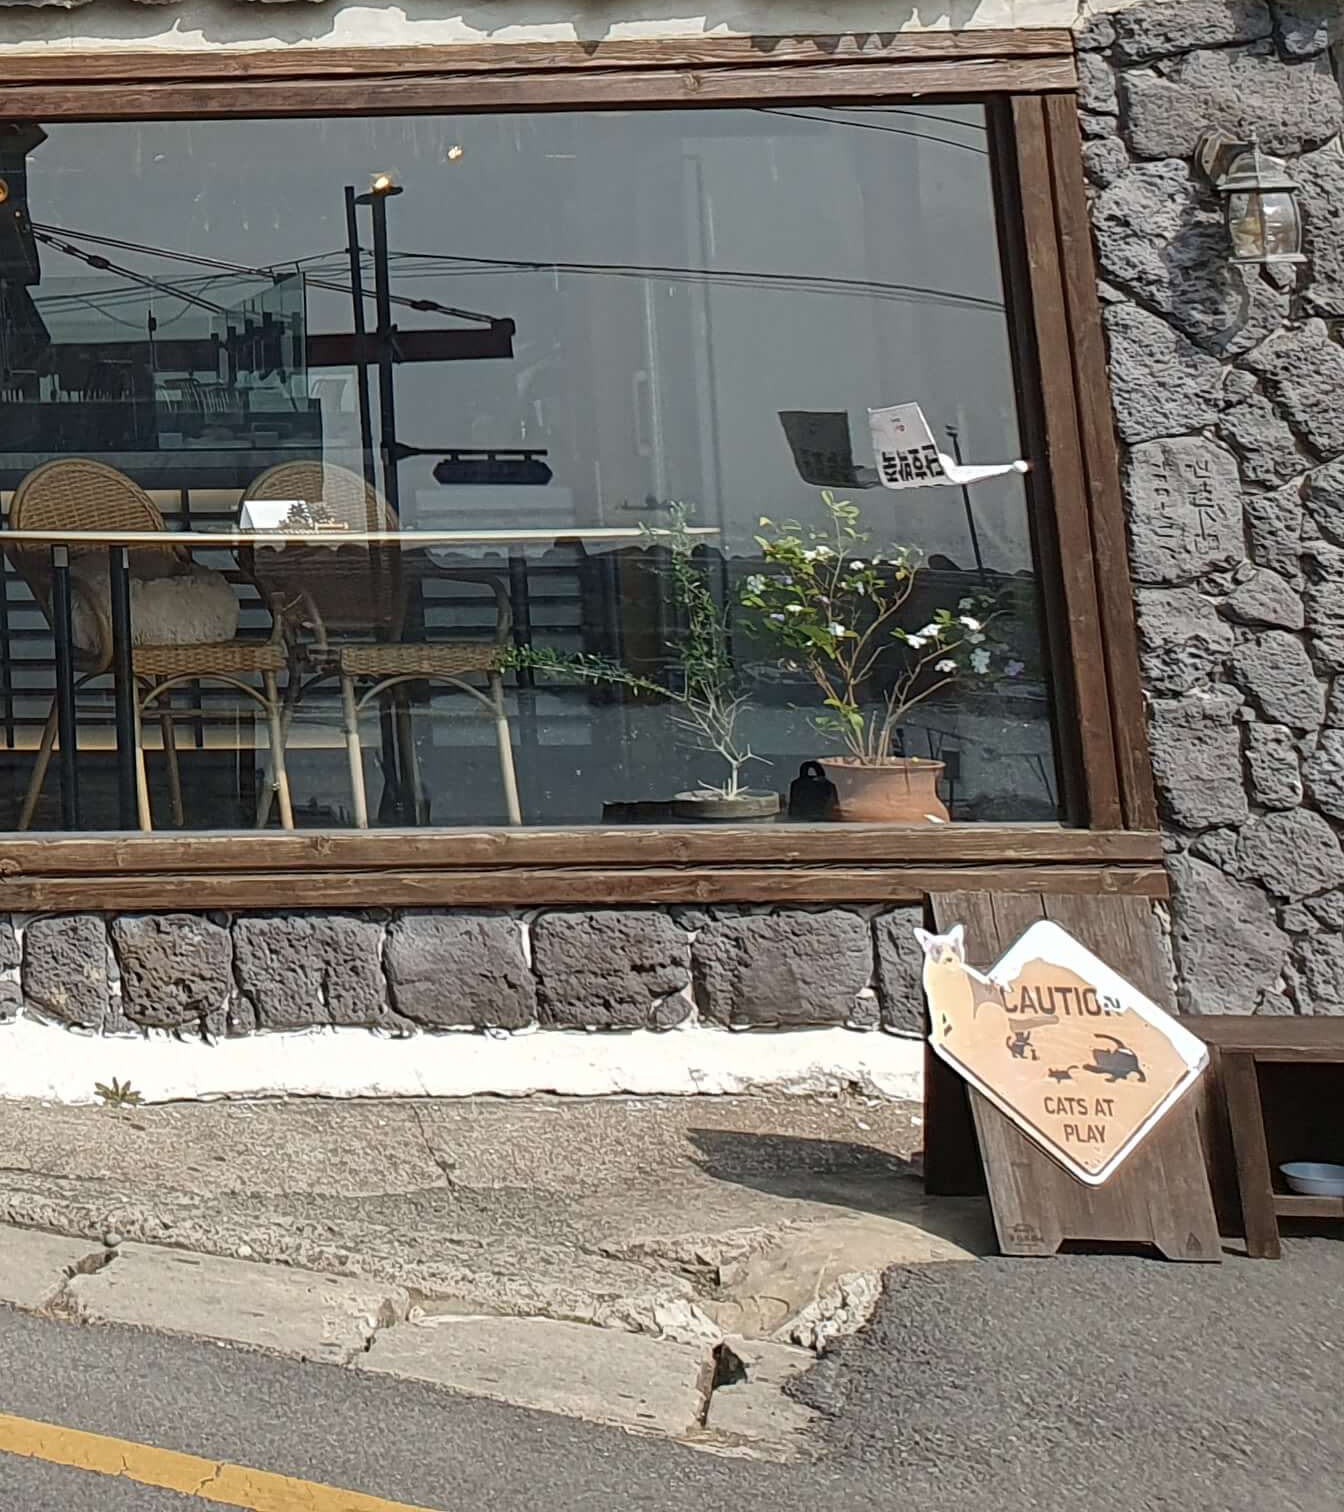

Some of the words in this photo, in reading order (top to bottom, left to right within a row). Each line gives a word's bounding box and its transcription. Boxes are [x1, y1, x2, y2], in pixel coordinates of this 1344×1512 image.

[1043, 1096, 1089, 1117] CATS
[1095, 1098, 1115, 1118] AT
[1063, 1123, 1106, 1144] PLAY
